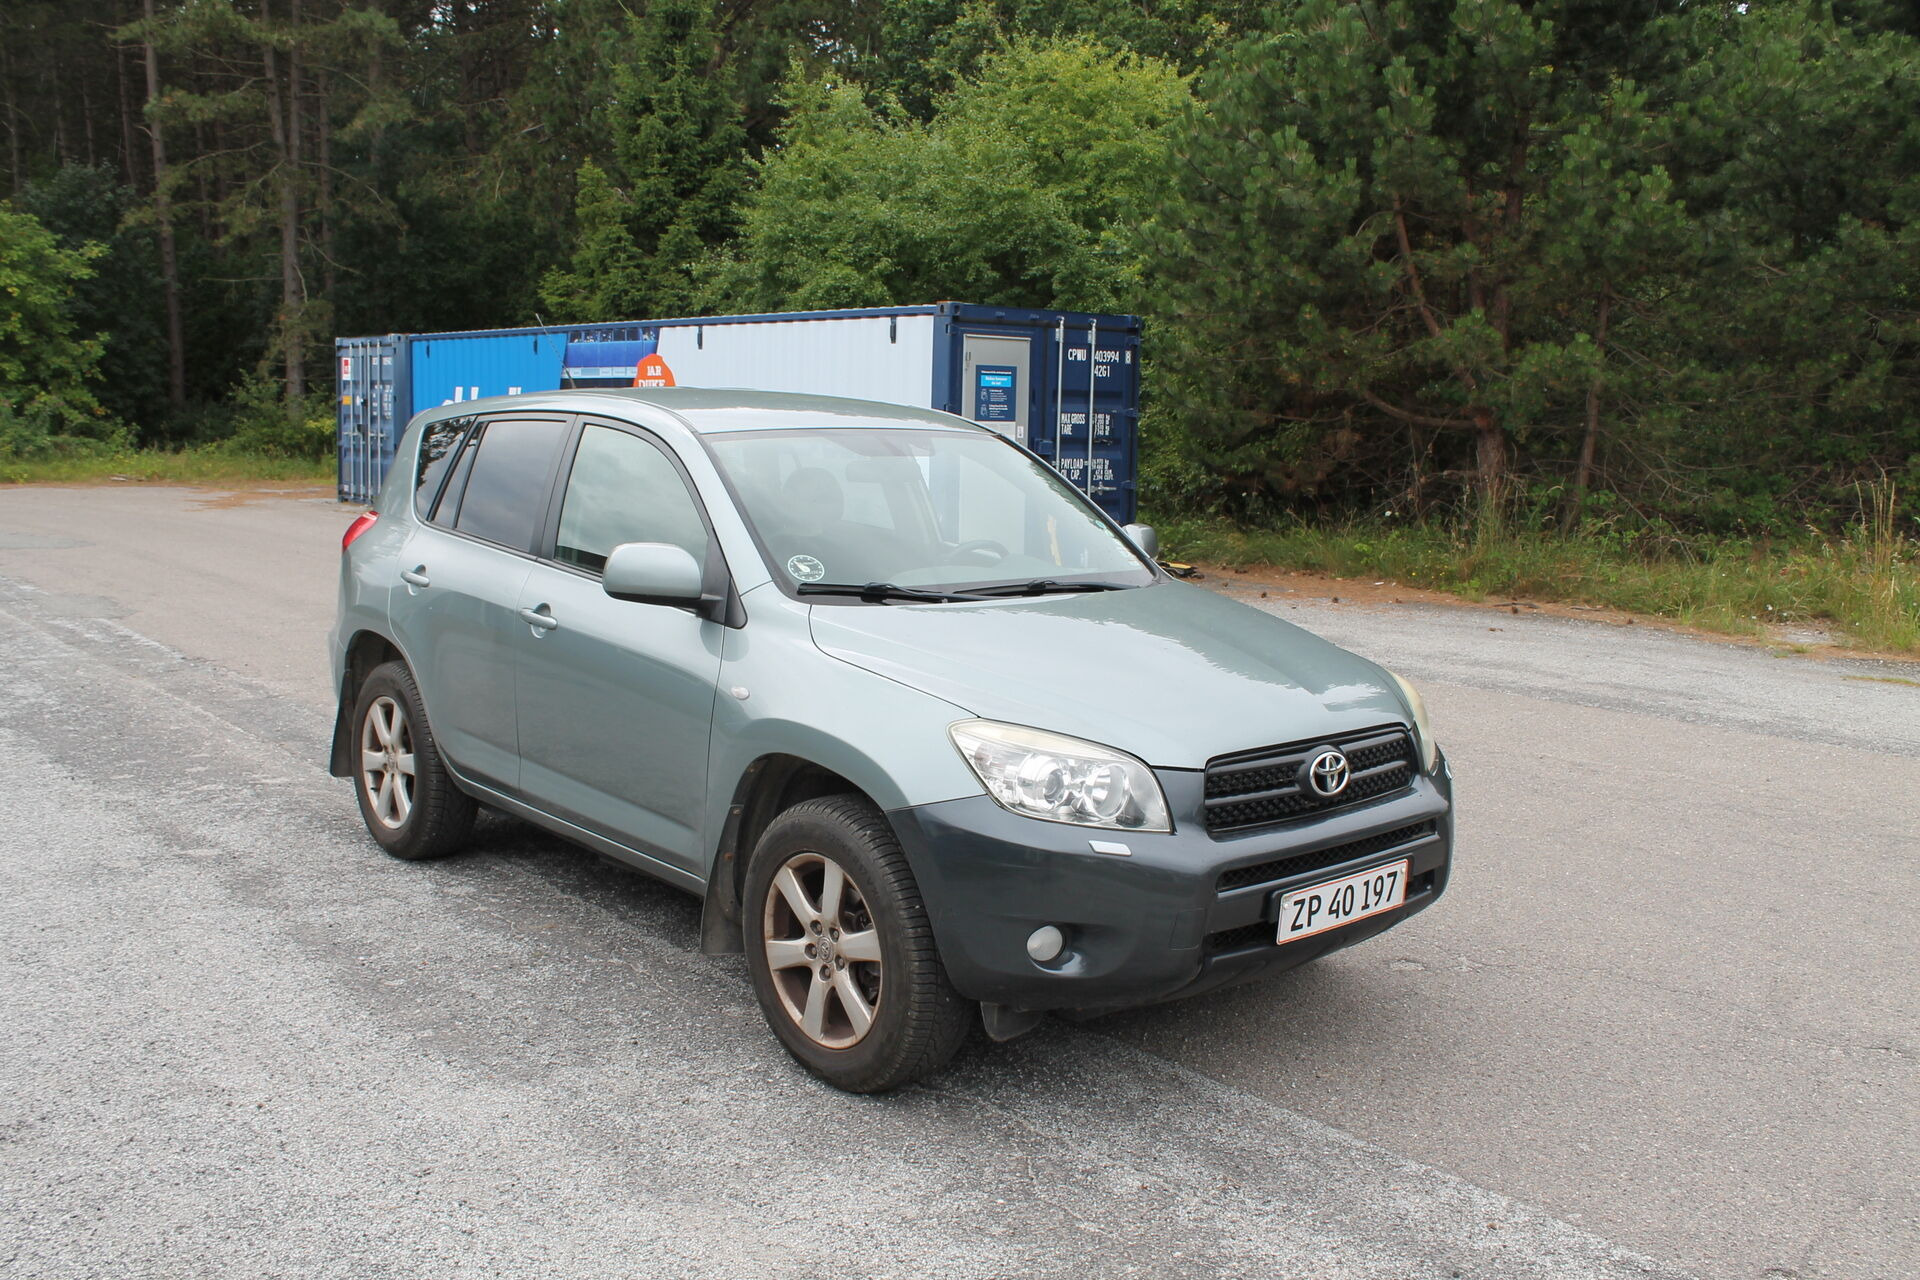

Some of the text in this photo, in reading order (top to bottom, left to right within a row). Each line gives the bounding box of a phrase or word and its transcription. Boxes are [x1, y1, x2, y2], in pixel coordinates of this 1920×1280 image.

[1068, 348, 1087, 361] CPWU
[1094, 350, 1120, 363] 403994
[1094, 365, 1110, 377] 42G1
[1061, 413, 1071, 424] MAX
[1071, 413, 1086, 424] GROSS
[1061, 424, 1073, 435] TARE
[1060, 458, 1084, 469] PAYLOAD
[1070, 469, 1082, 480] CAP.
[1290, 870, 1398, 932] ZP 40 197
